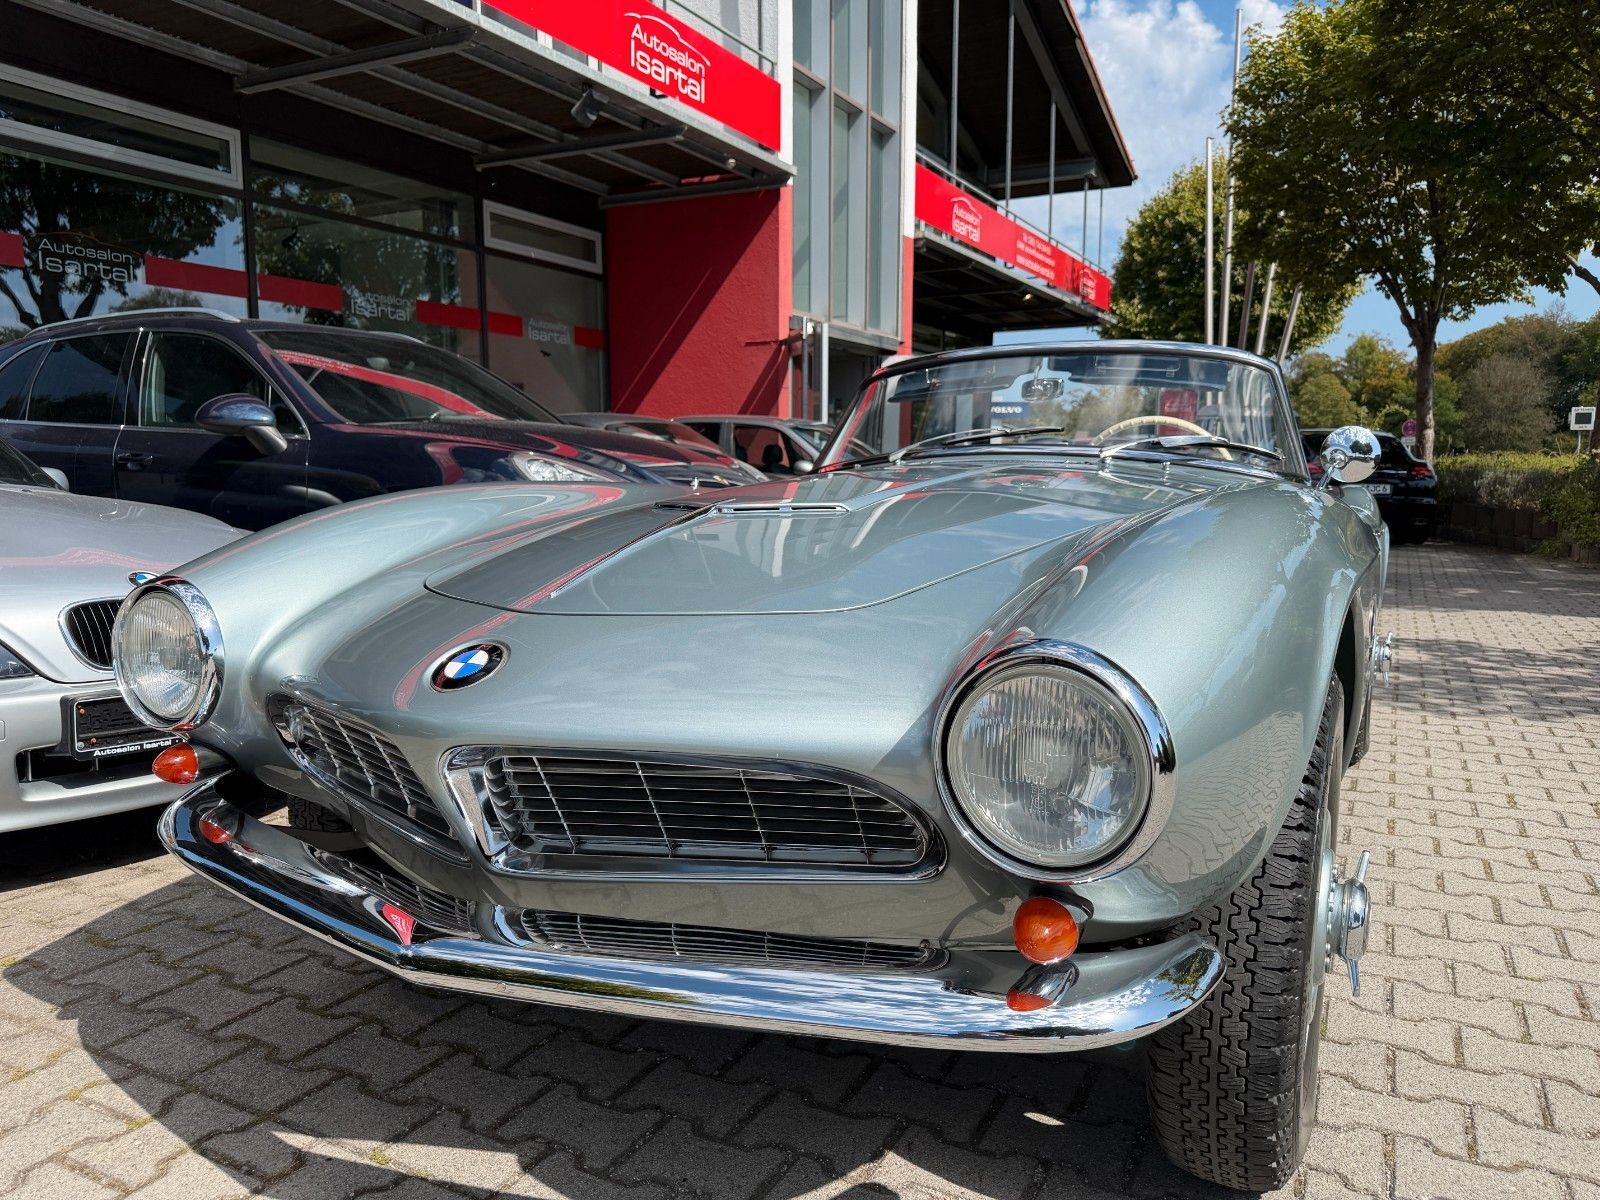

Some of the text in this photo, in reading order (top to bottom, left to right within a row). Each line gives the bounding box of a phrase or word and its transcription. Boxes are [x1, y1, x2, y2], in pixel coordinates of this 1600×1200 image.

[631, 23, 705, 78] Autosalon
[630, 38, 705, 104] Isartal
[952, 203, 980, 226] Autosalon
[952, 213, 981, 243] Isartal
[38, 238, 133, 264] Autosalon
[38, 250, 135, 282] Isartal
[351, 298, 410, 322] Isartal
[528, 326, 571, 345] Isartal
[93, 744, 141, 757] Autosalon
[143, 739, 172, 749] Isartal
